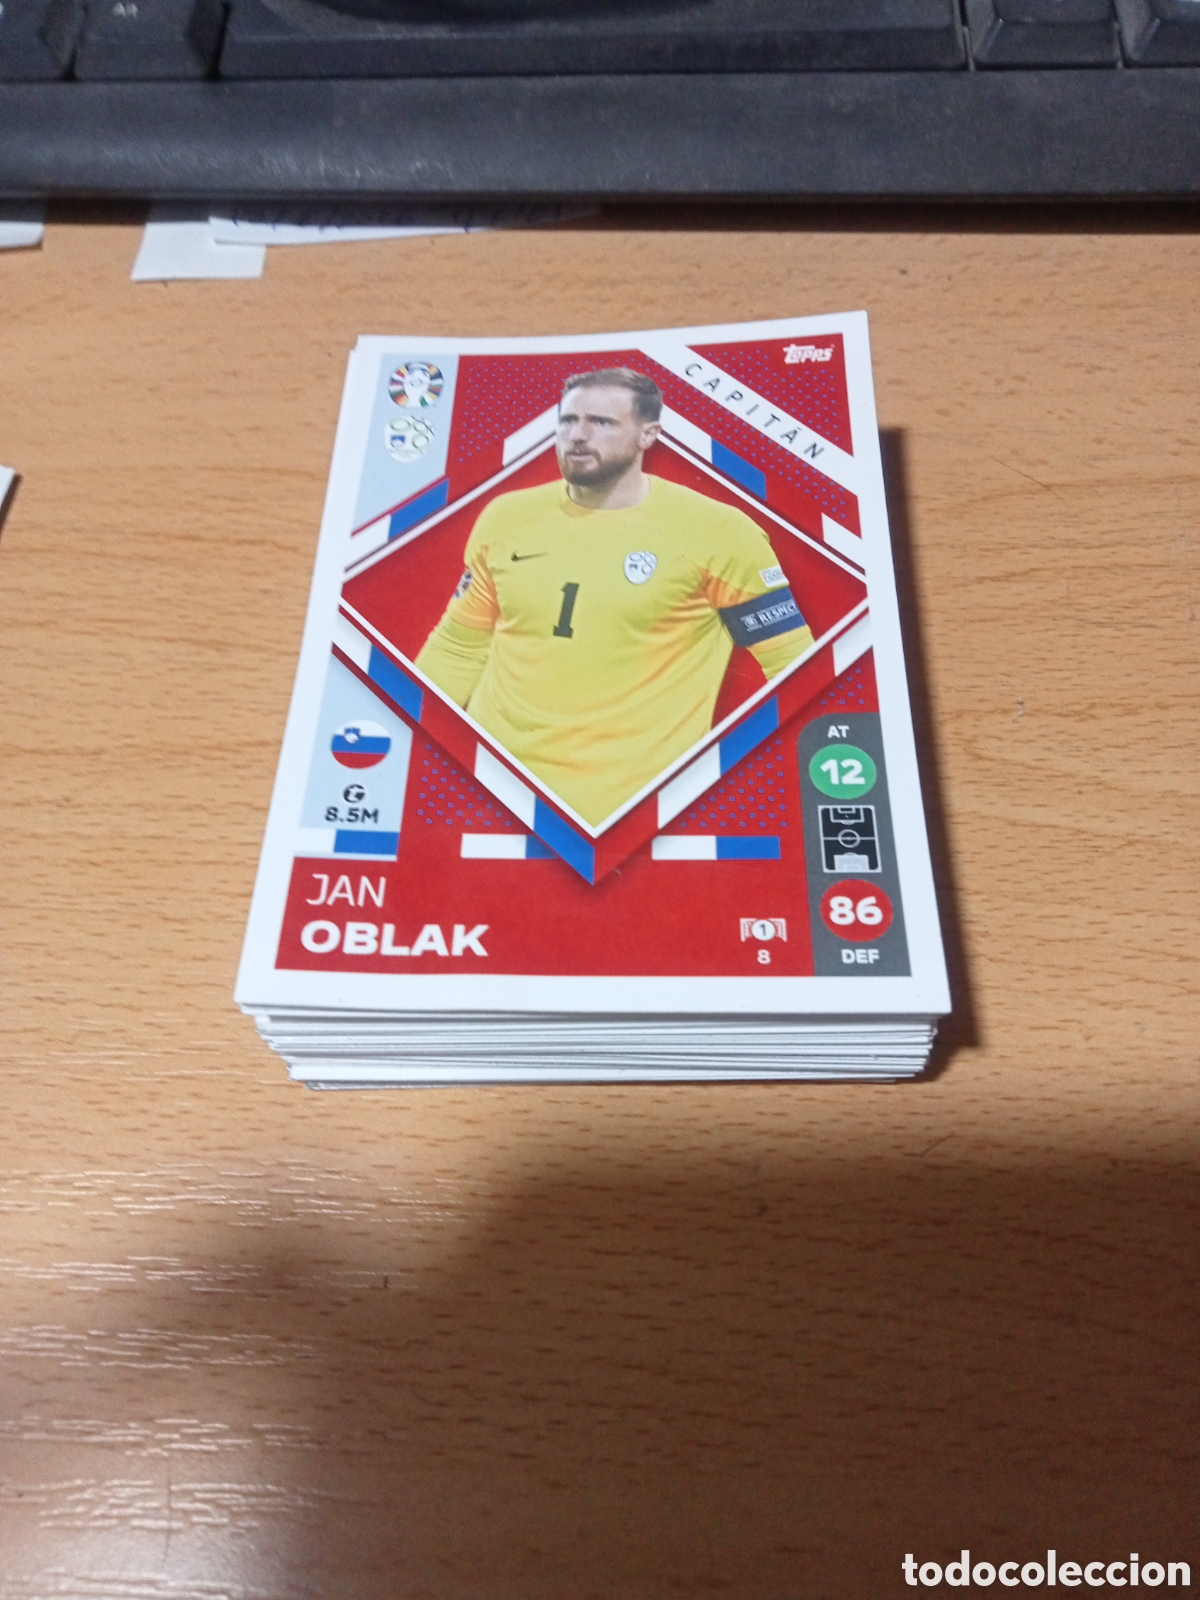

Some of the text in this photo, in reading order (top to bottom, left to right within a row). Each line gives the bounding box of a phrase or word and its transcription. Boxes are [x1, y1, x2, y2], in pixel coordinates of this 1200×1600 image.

[685, 363, 825, 460] CAPITÁN
[552, 581, 580, 639] 1
[827, 725, 850, 738] AT
[820, 759, 866, 785] 12
[324, 806, 379, 824] 8.5M
[306, 873, 387, 908] JAN
[829, 896, 884, 926] 86
[301, 920, 490, 957] OBLAK
[757, 949, 771, 965] 8
[841, 949, 880, 964] DEF
